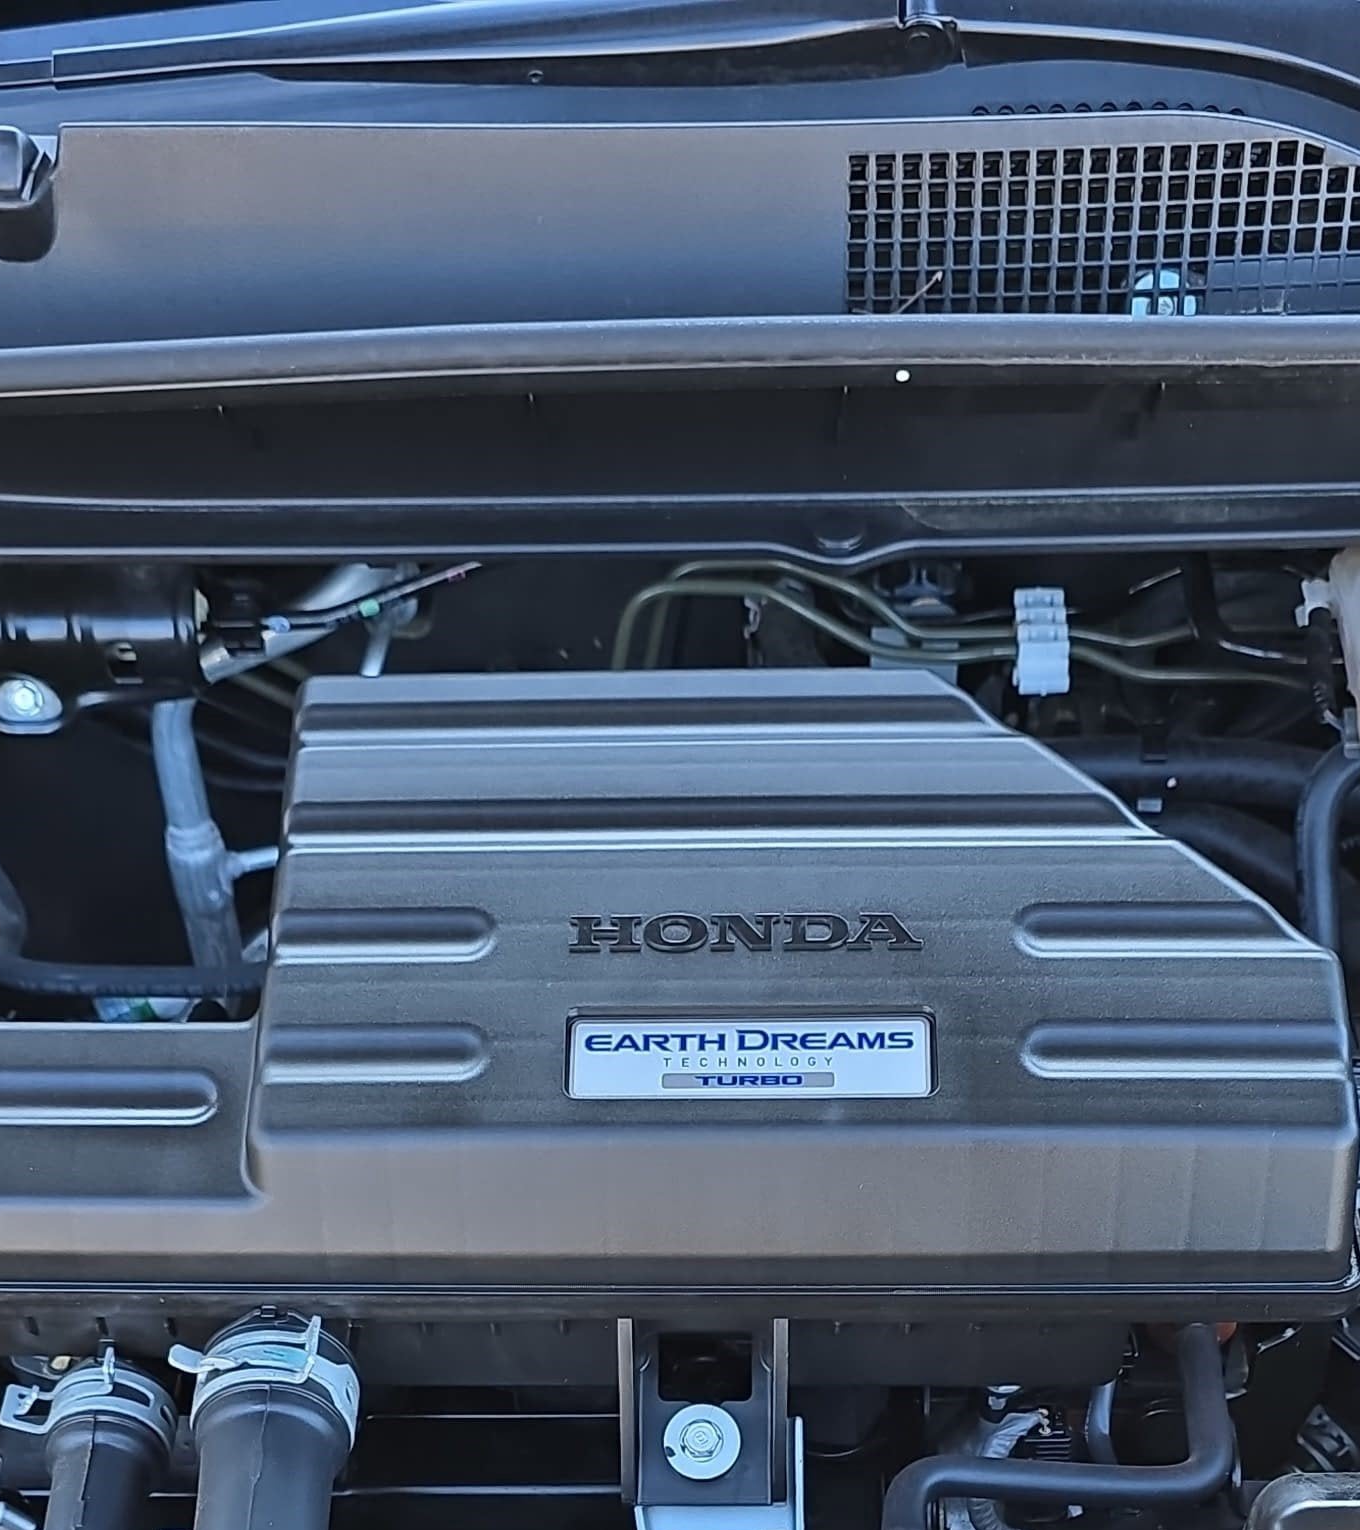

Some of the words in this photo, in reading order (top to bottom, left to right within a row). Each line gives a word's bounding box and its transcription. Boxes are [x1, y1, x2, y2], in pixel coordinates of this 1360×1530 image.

[569, 911, 924, 953] HONDA
[584, 1032, 726, 1053] EARTH
[663, 1056, 834, 1068] TECHNOLOGY
[694, 1075, 803, 1087] TURBO
